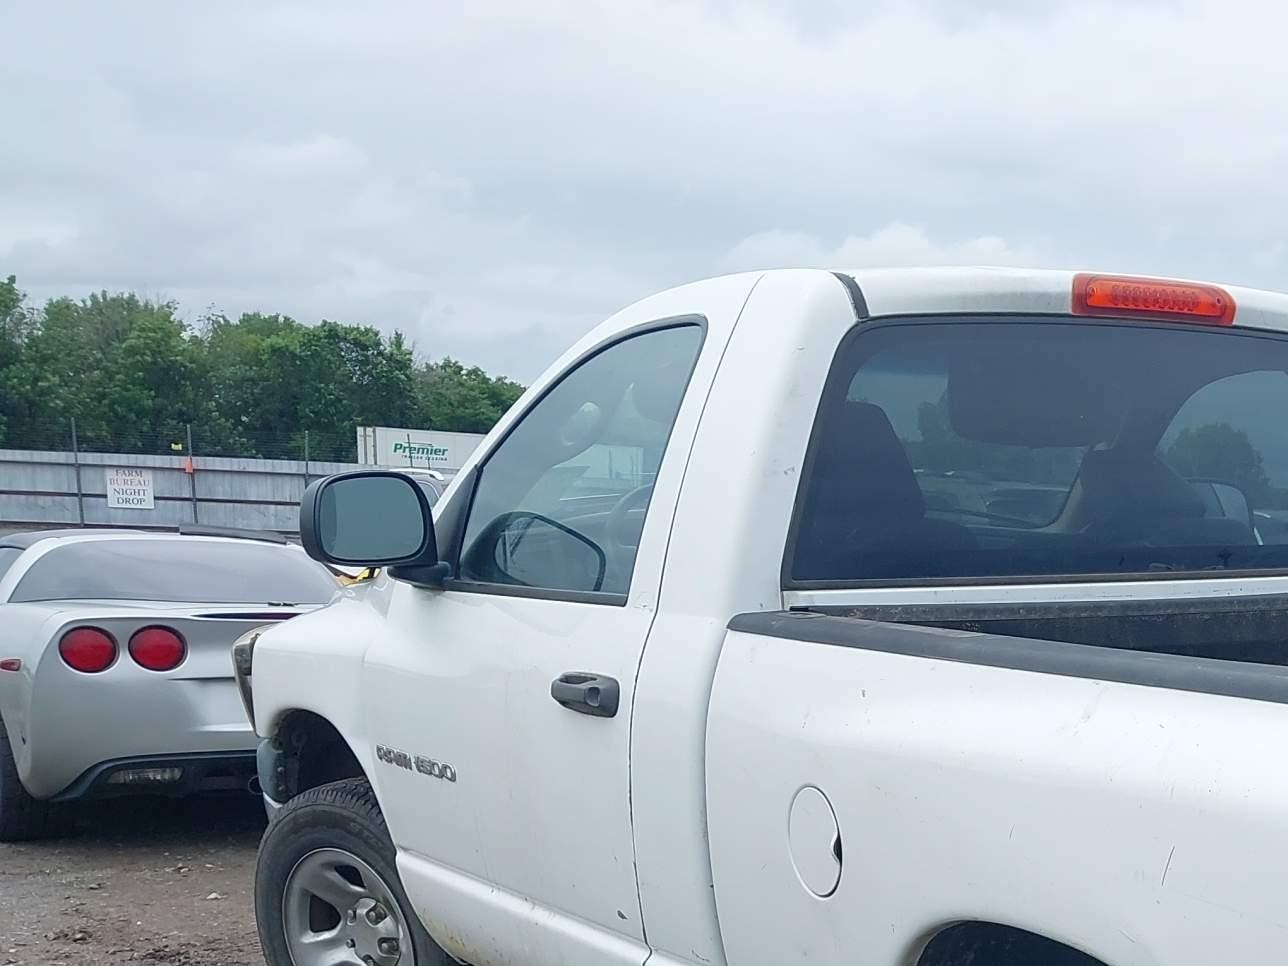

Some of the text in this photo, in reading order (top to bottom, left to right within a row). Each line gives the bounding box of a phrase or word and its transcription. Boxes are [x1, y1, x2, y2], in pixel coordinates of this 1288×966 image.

[393, 443, 448, 456] Premier
[115, 469, 143, 478] FARM
[109, 478, 150, 487] BUREAU
[113, 488, 147, 497] NIGHT
[117, 497, 146, 505] DROP
[376, 744, 456, 783] RAM 1500
